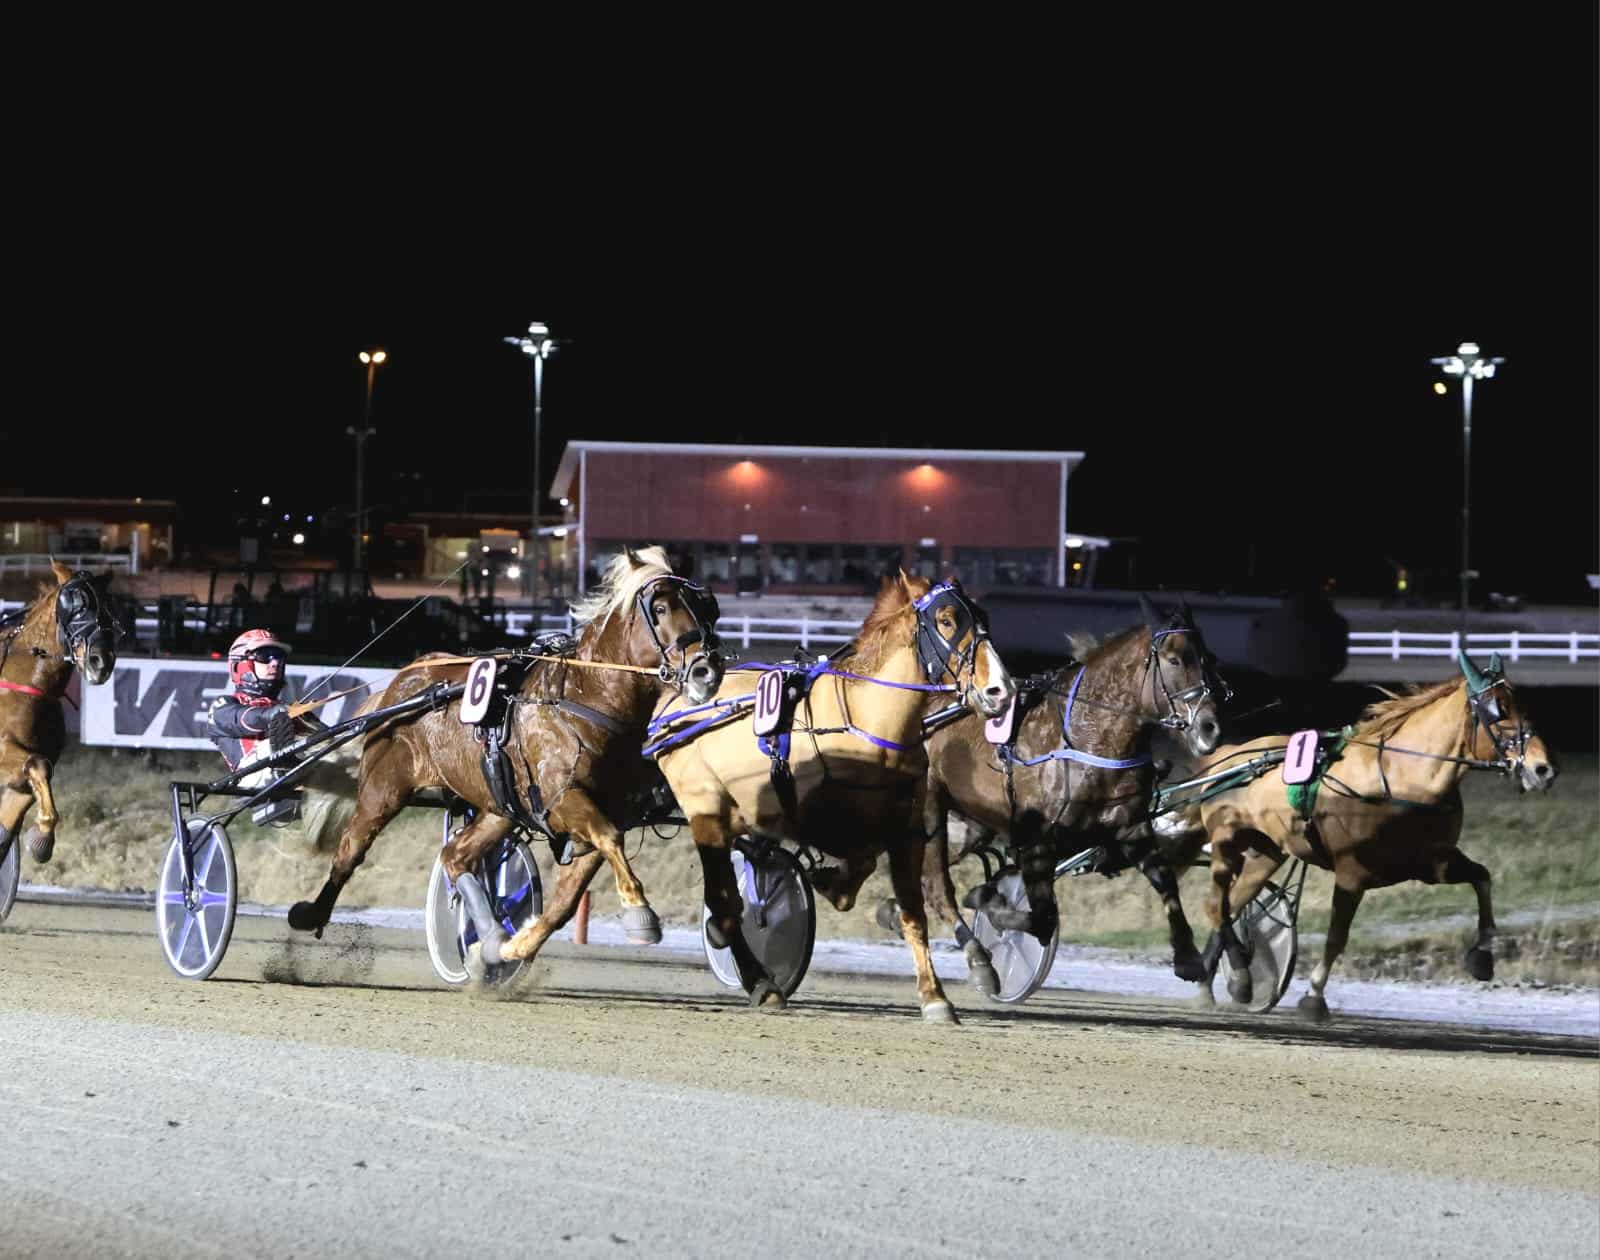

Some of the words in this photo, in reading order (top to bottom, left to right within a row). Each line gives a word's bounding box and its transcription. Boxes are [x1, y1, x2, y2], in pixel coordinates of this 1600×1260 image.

[470, 660, 491, 706] 6
[758, 671, 781, 719] 10
[1295, 733, 1307, 768] 1
